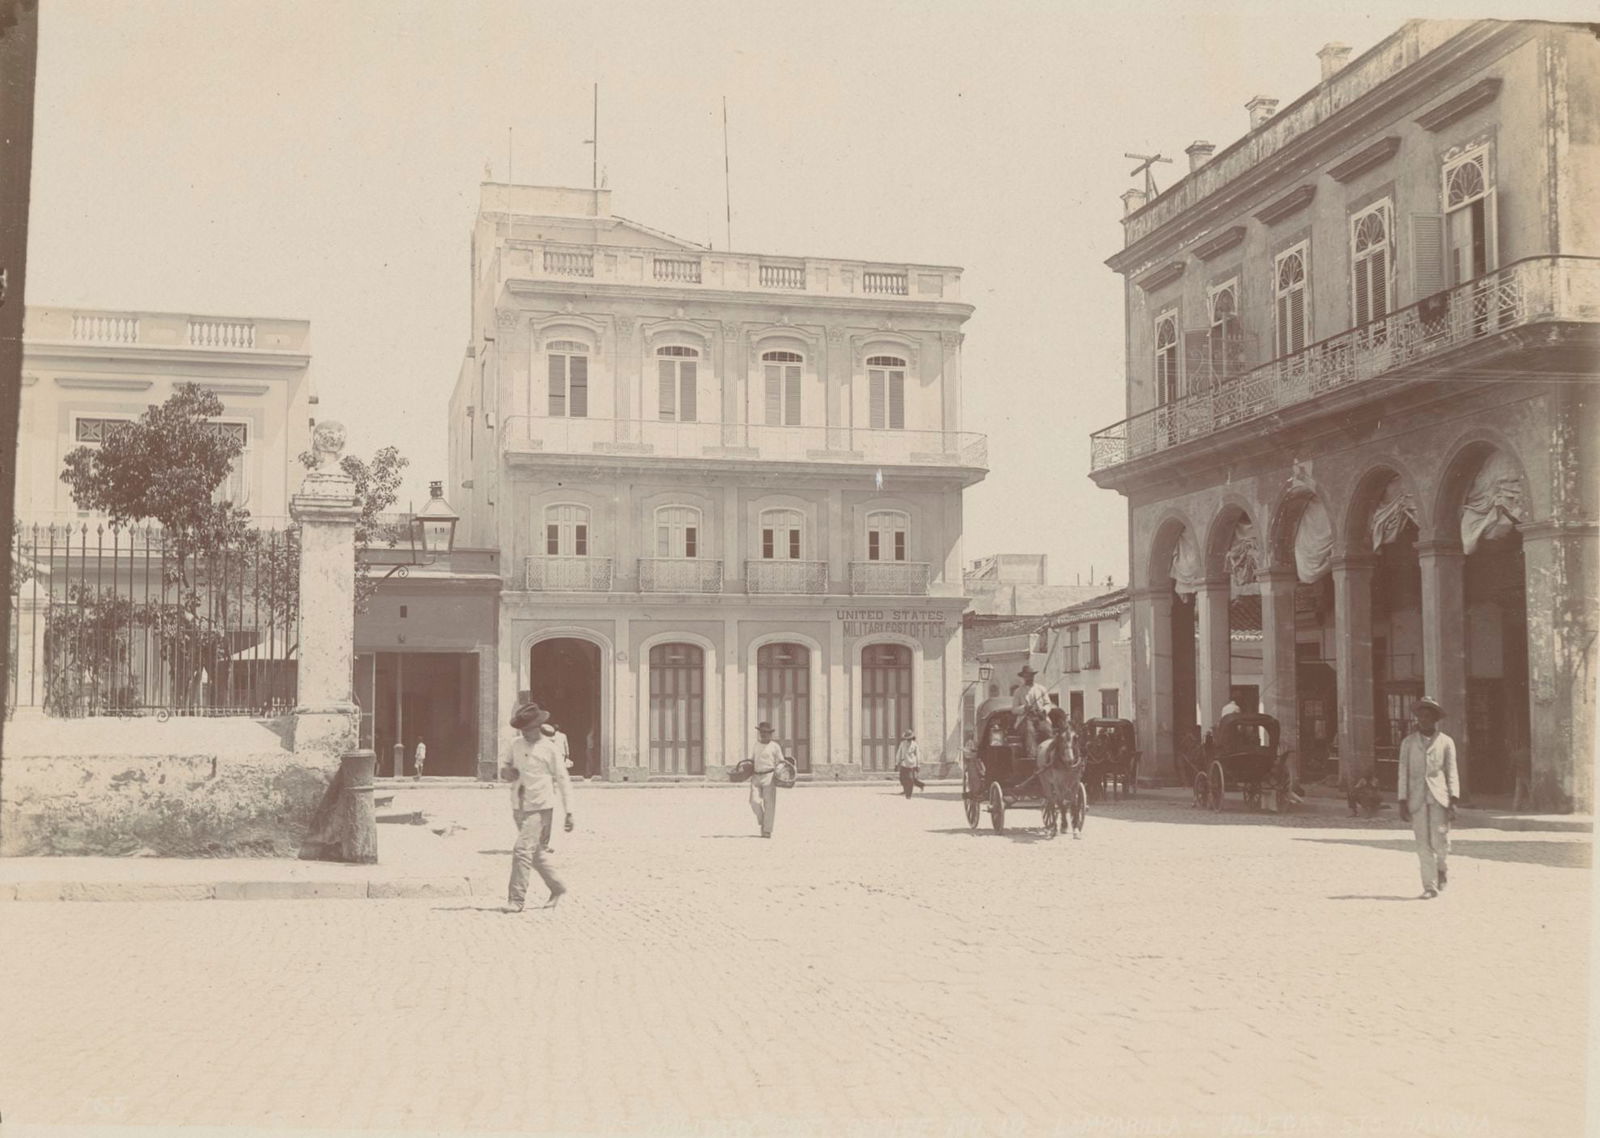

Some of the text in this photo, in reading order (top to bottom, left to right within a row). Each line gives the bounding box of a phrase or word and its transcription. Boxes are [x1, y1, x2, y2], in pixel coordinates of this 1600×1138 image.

[836, 609, 884, 620] UNITED
[843, 621, 883, 637] MILITARY
[885, 621, 908, 633] POST
[910, 621, 945, 638] OFFICE
